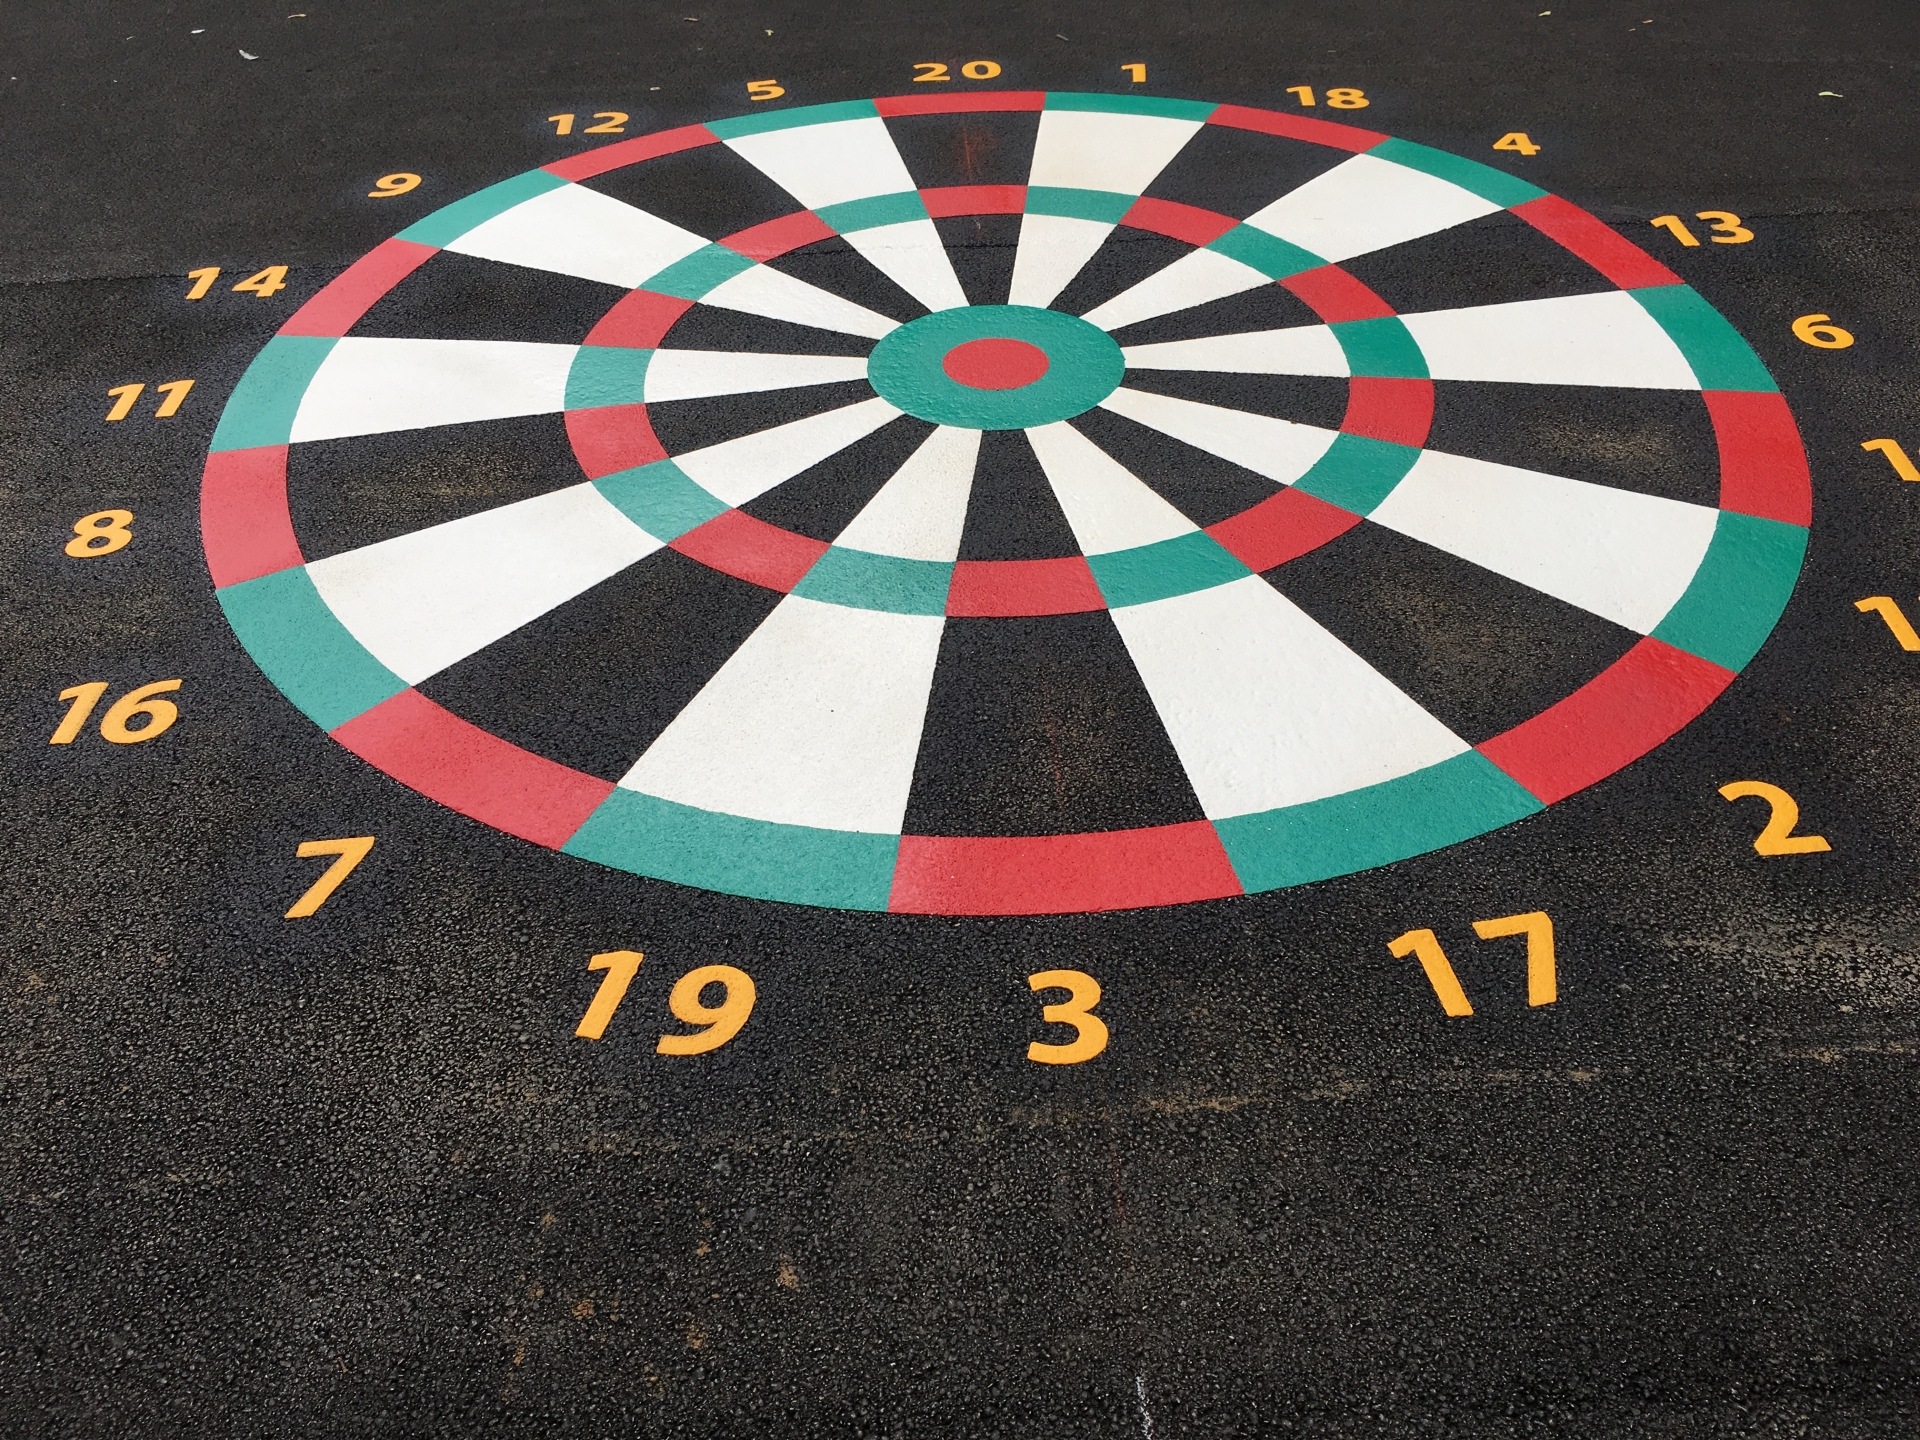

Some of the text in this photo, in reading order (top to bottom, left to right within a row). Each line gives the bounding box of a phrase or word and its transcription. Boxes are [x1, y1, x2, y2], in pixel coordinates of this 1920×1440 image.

[746, 79, 786, 101] 5
[914, 60, 1002, 82] 20
[1122, 63, 1147, 83] 1
[1286, 85, 1370, 110] 18
[547, 111, 629, 136] 12
[1492, 132, 1541, 156] 4
[368, 172, 423, 198] 9
[1651, 210, 1755, 248] 13
[184, 265, 289, 300] 14
[1791, 313, 1855, 350] 6
[106, 379, 195, 422] 11
[1860, 438, 1920, 482] 1
[64, 508, 134, 558] 8
[1854, 595, 1920, 652] 1
[49, 678, 182, 745] 16
[1718, 780, 1832, 857] 2
[284, 835, 376, 920] 7
[1386, 910, 1558, 1018] 17
[574, 949, 757, 1057] 19
[1026, 969, 1109, 1065] 3
